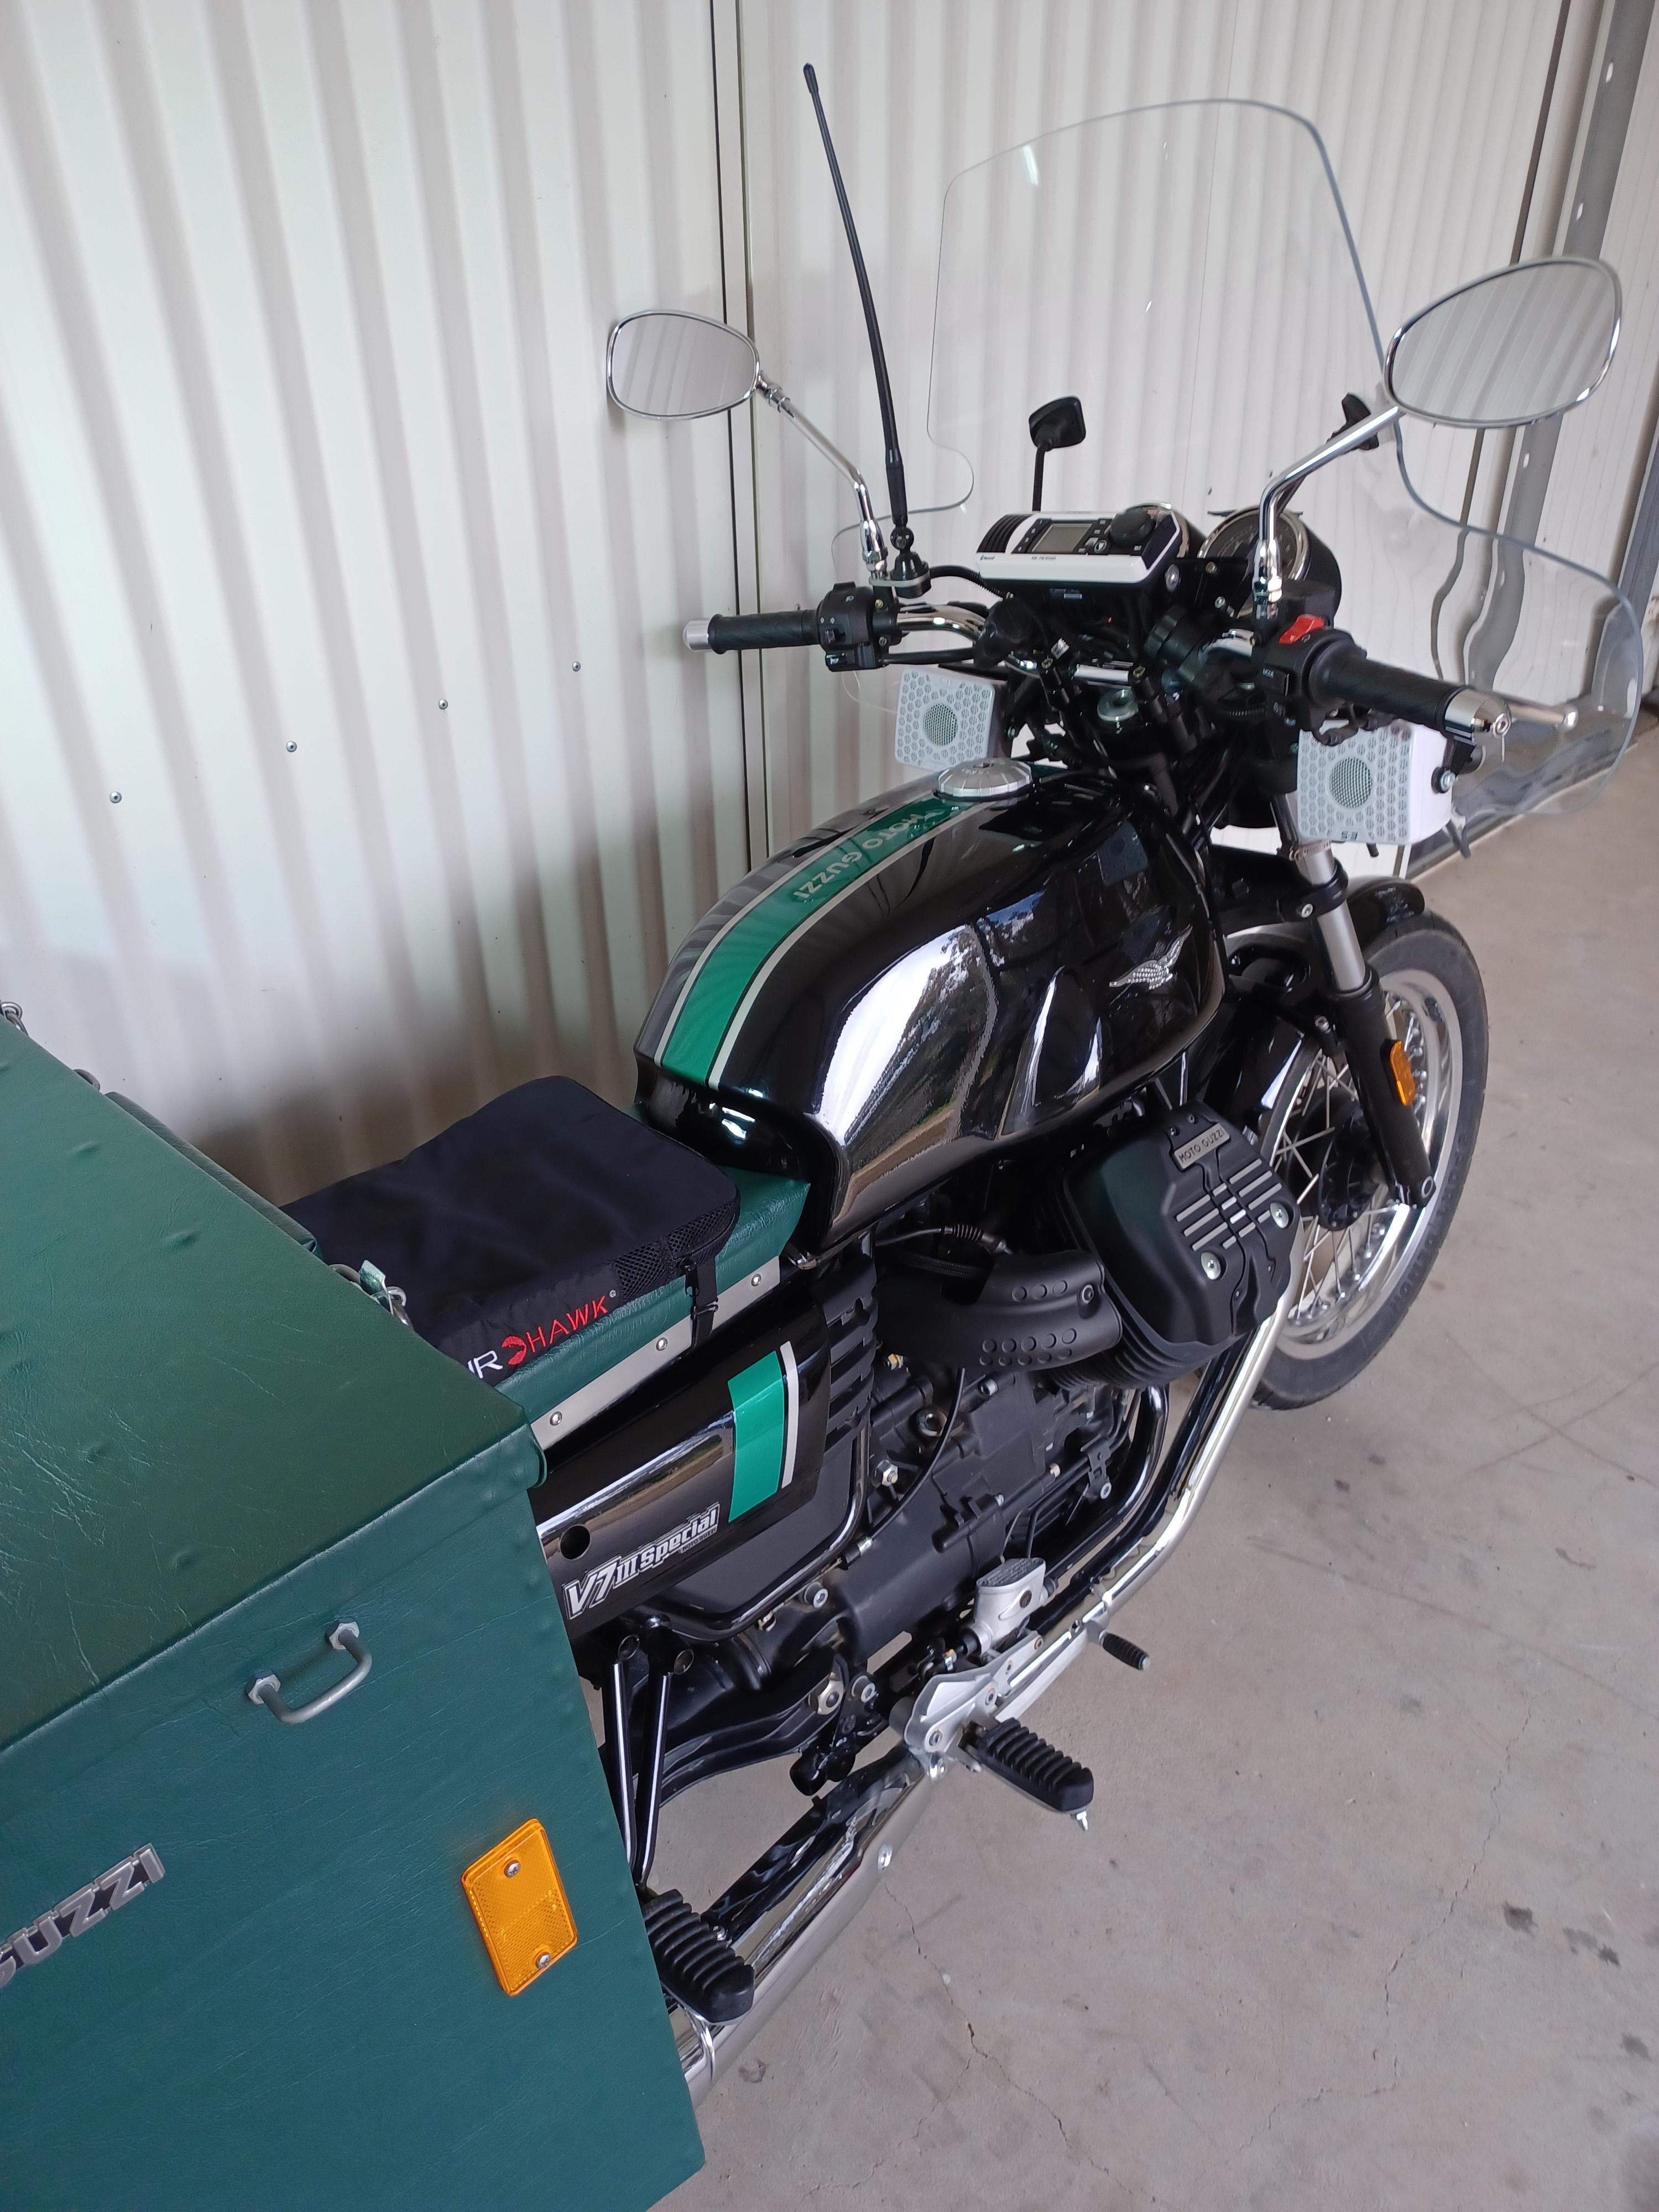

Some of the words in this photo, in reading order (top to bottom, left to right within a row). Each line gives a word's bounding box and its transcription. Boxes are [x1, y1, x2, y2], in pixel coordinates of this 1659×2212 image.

[794, 851, 863, 899] GUZZI
[1178, 1144, 1201, 1163] MOTO
[682, 1539, 698, 1551] MOTO
